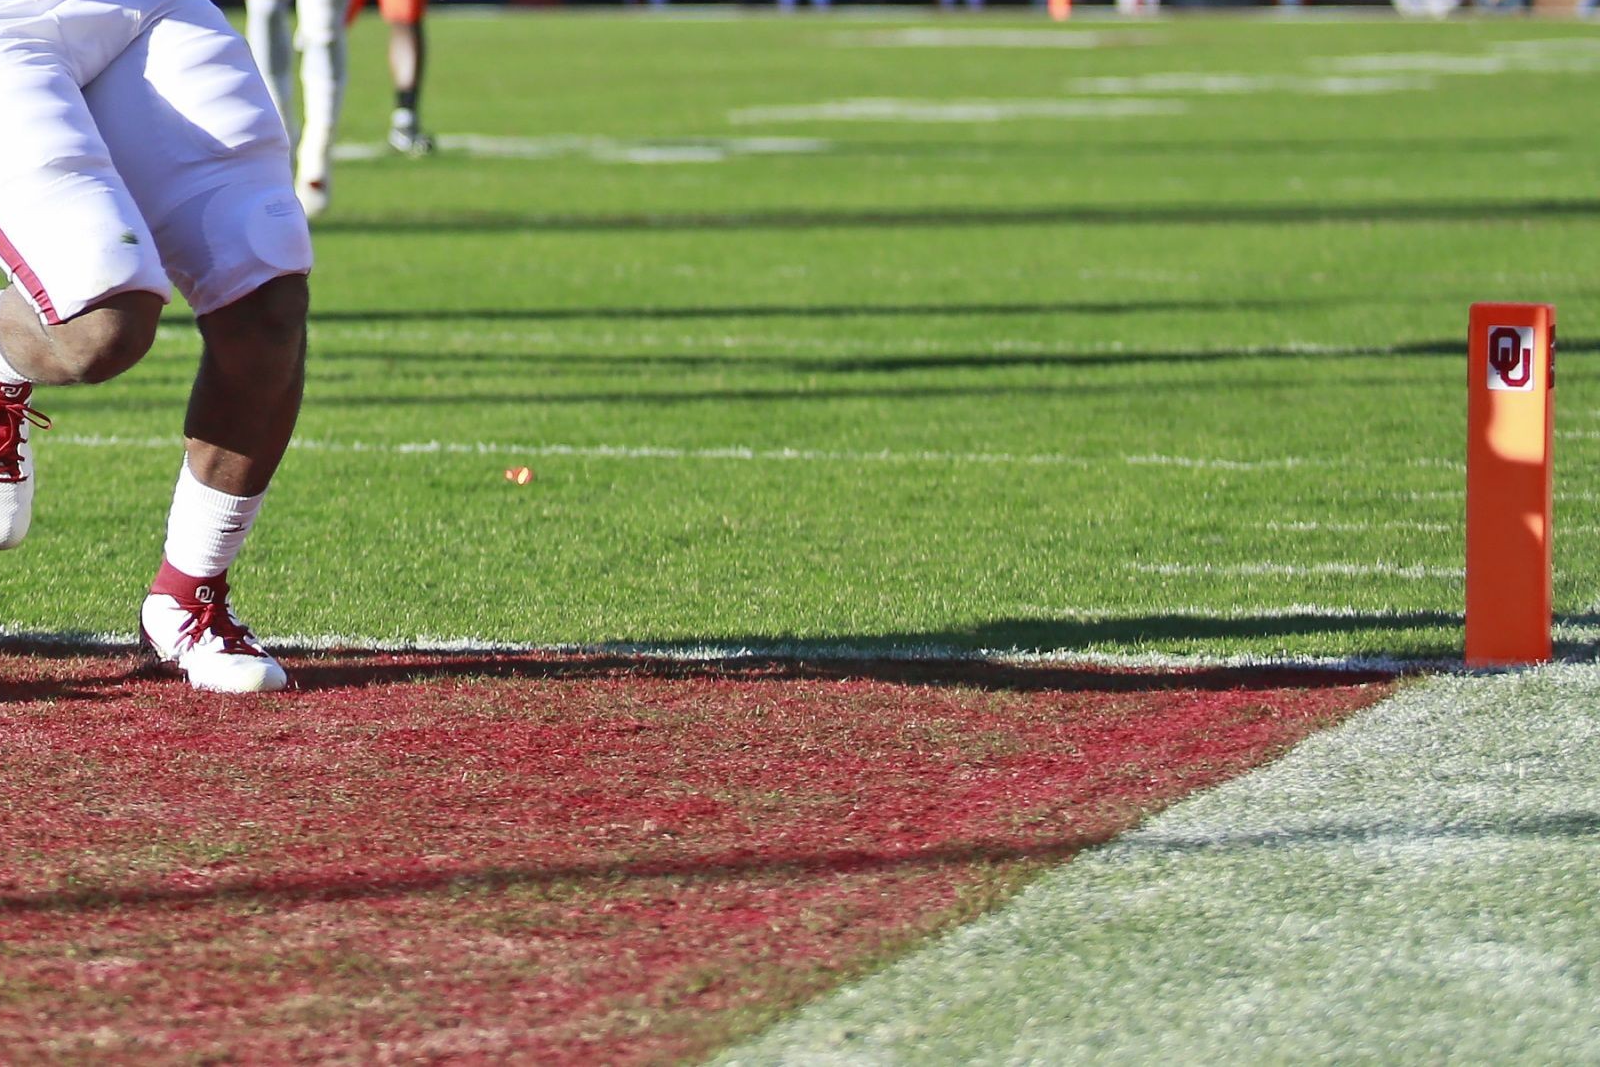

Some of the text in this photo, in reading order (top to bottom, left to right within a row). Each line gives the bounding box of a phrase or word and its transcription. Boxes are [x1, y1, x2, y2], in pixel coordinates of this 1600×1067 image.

[1489, 327, 1531, 387] OU
[0, 386, 23, 398] OU
[195, 585, 215, 603] OU
